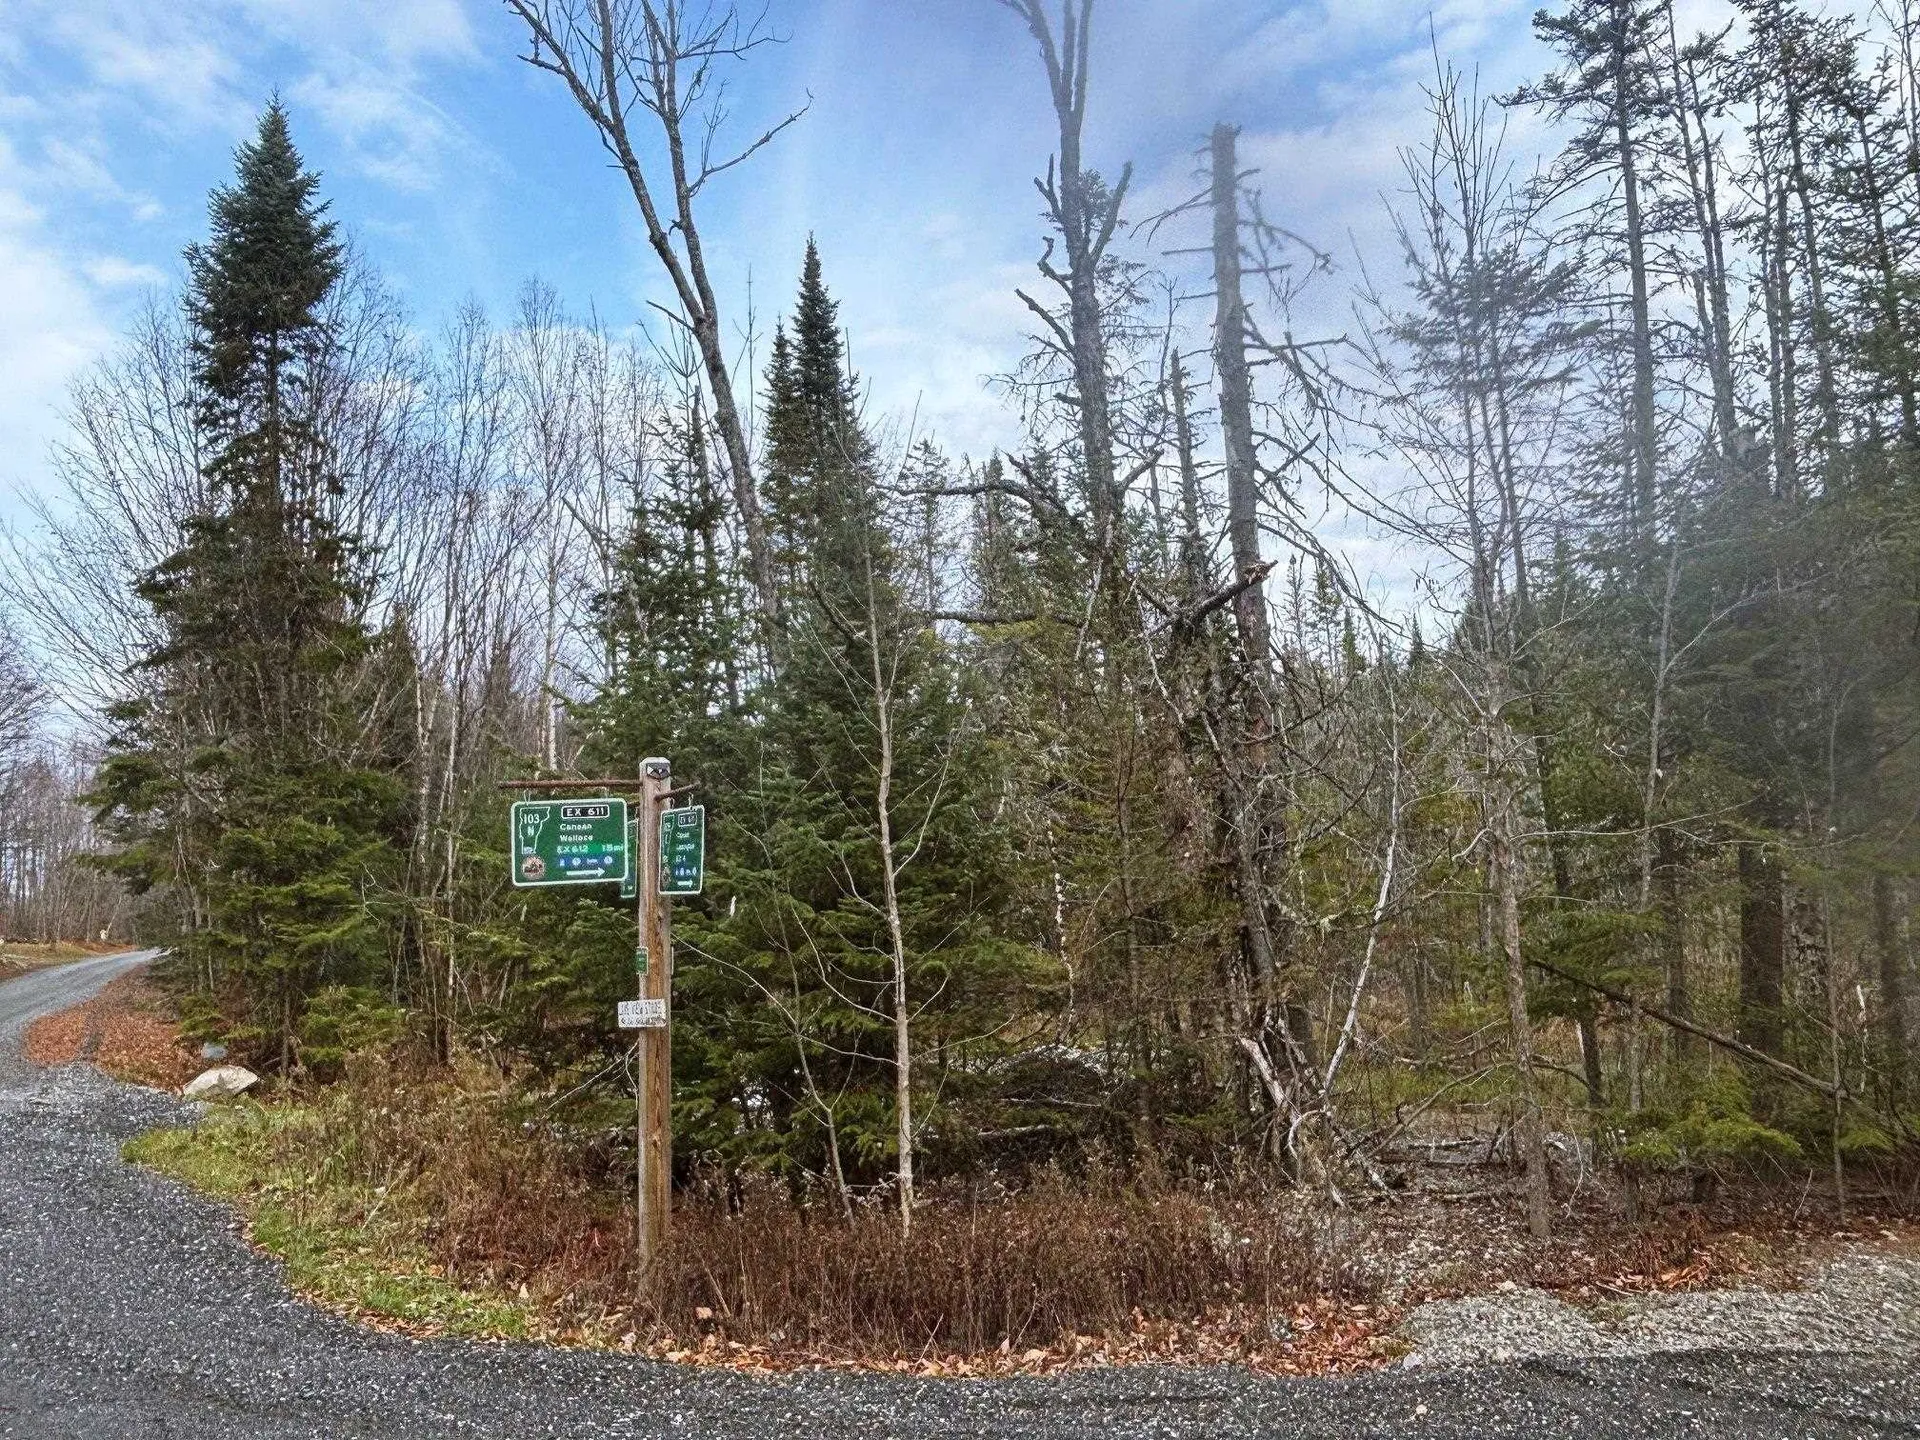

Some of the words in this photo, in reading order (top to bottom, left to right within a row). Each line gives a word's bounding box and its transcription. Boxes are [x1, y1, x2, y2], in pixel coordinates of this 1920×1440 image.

[588, 807, 604, 816] 611
[523, 814, 540, 824] 103
[527, 826, 535, 836] N
